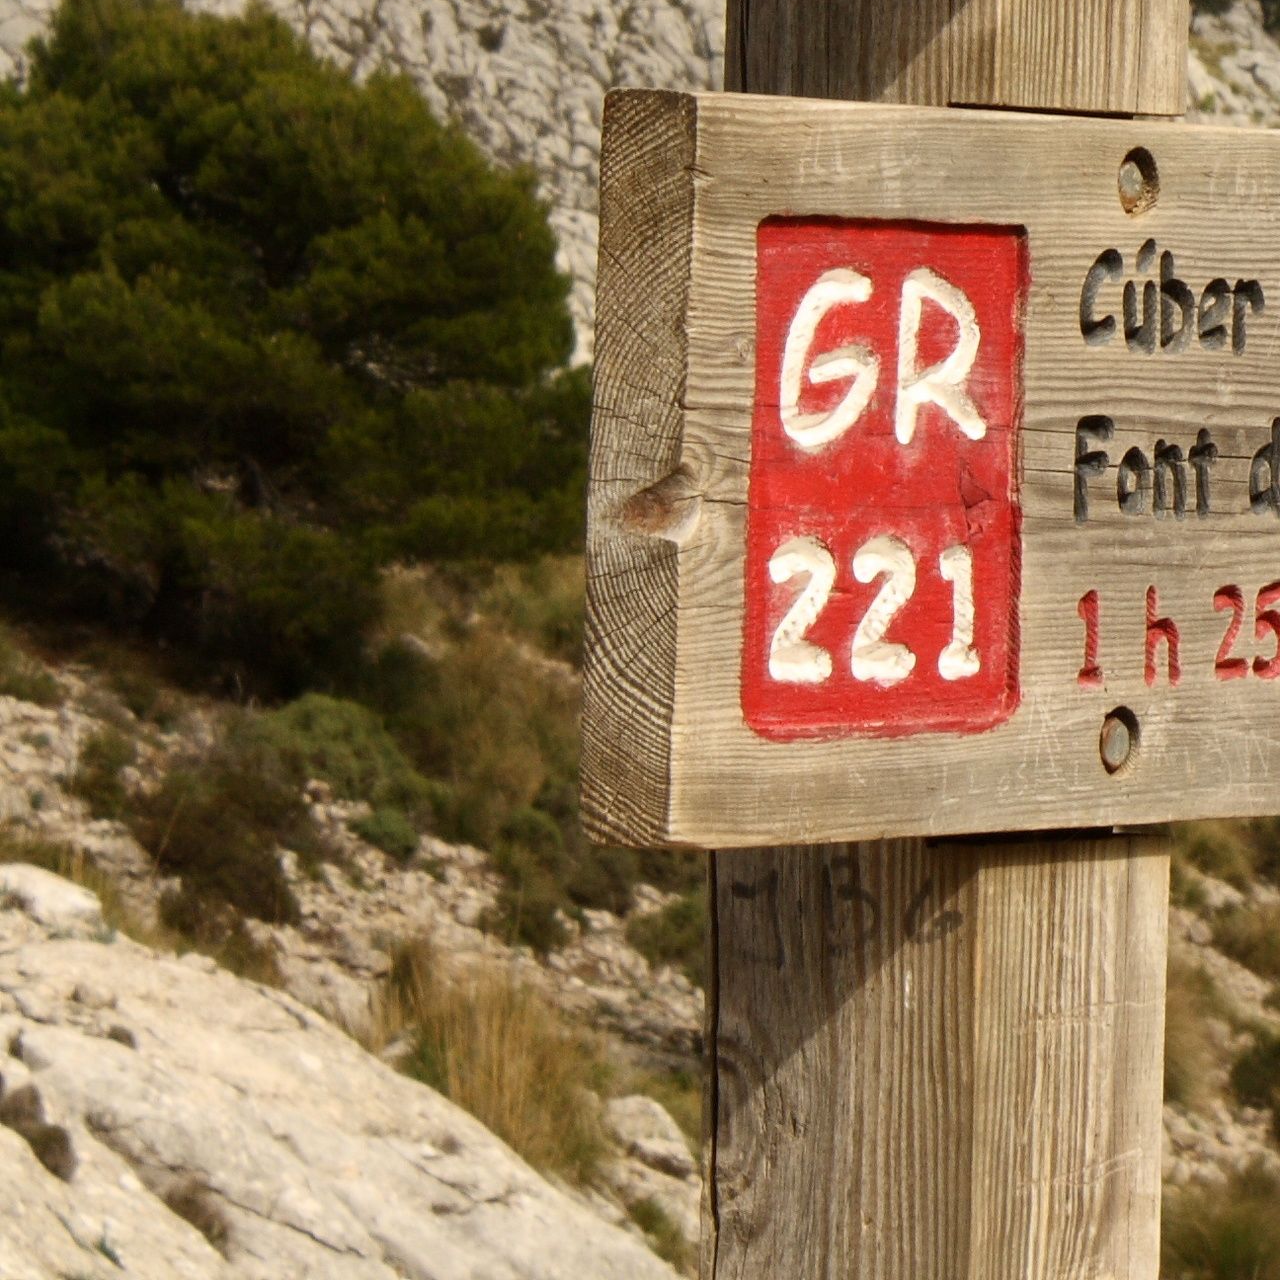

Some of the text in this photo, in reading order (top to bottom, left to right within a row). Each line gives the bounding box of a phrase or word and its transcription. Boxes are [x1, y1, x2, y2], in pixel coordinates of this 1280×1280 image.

[1079, 237, 1266, 356] Cúber
[780, 266, 987, 454] GR
[1073, 414, 1219, 521] Font
[768, 535, 982, 683] 221
[1077, 589, 1105, 687] 1
[1144, 584, 1182, 687] h
